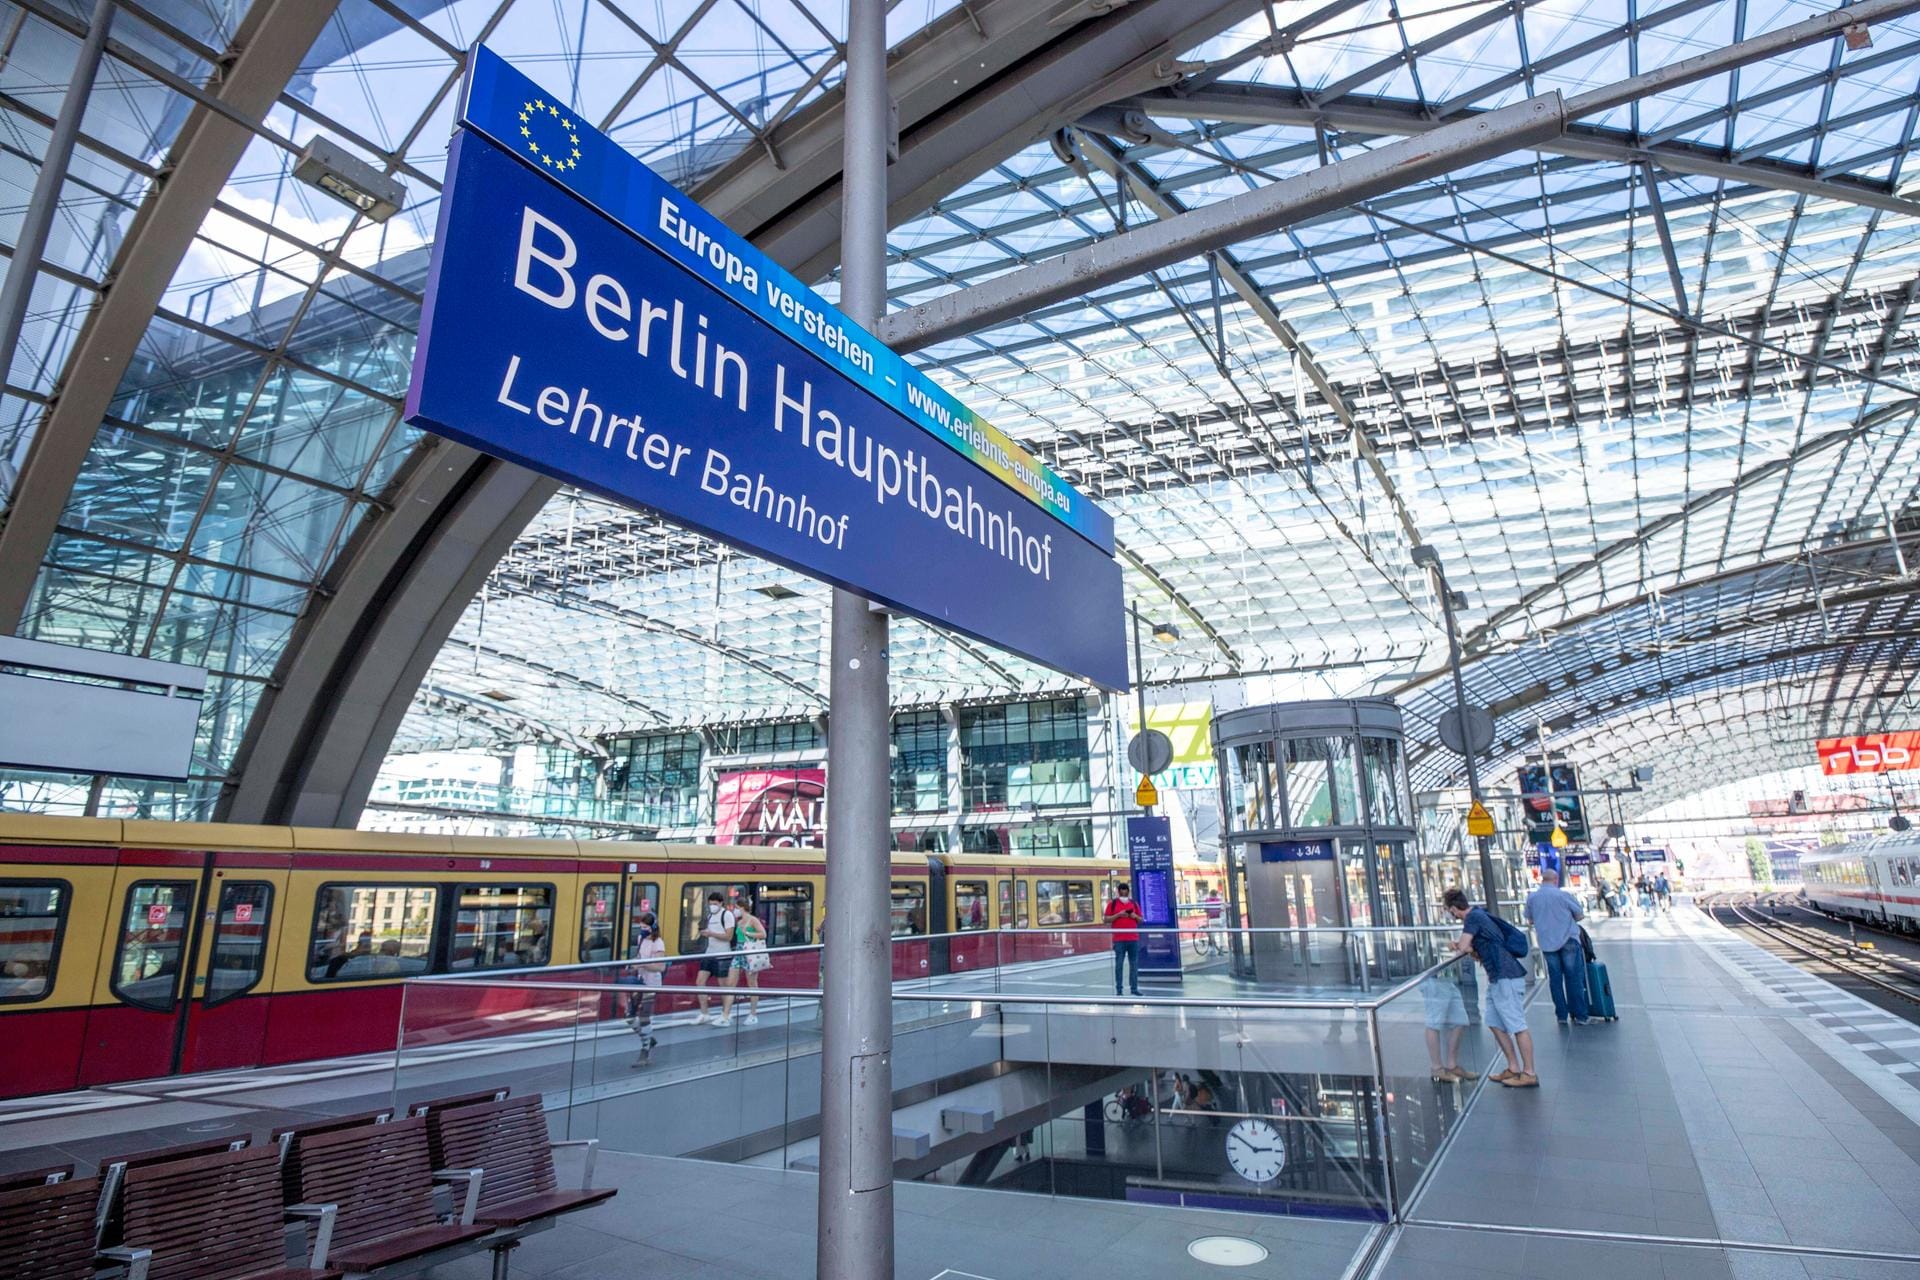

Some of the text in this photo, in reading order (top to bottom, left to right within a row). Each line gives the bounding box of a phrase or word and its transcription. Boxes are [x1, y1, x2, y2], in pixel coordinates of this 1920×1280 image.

[497, 354, 850, 550] Lehrter Bahnhof
[514, 205, 1052, 581] Berlin Hauptbahnhof
[659, 197, 759, 295] Europa
[766, 279, 874, 375] verstehen
[907, 382, 1071, 513] www.erlebnis-europa.eu
[1305, 845, 1321, 856] 3/4
[1829, 742, 1910, 768] rbb
